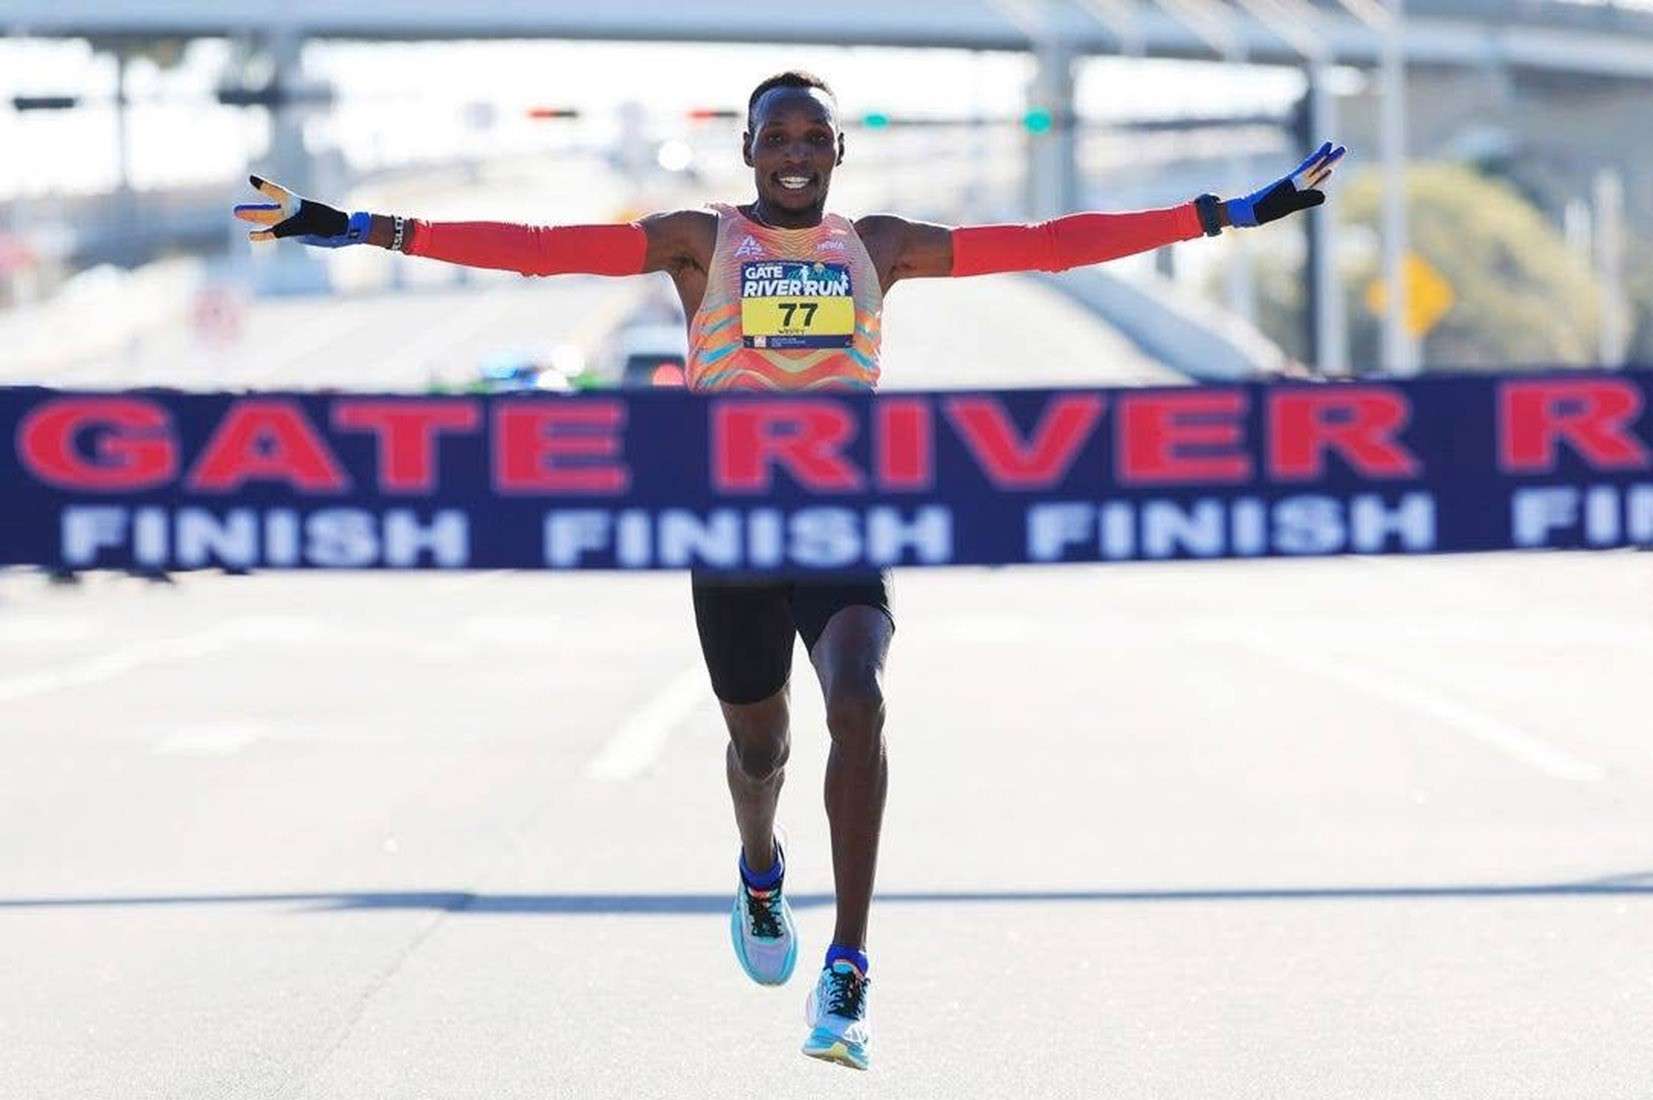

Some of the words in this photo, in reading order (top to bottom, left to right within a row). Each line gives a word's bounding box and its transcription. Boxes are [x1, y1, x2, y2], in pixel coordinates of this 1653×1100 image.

[745, 266, 783, 279] GATE
[743, 280, 802, 297] RIVER
[805, 280, 846, 296] RUN
[778, 303, 818, 327] 77
[19, 398, 627, 493] GATE
[713, 384, 1417, 493] RIVER
[61, 505, 469, 568] FINISH
[543, 505, 953, 567] FINISH
[1026, 493, 1436, 560] FINISH
